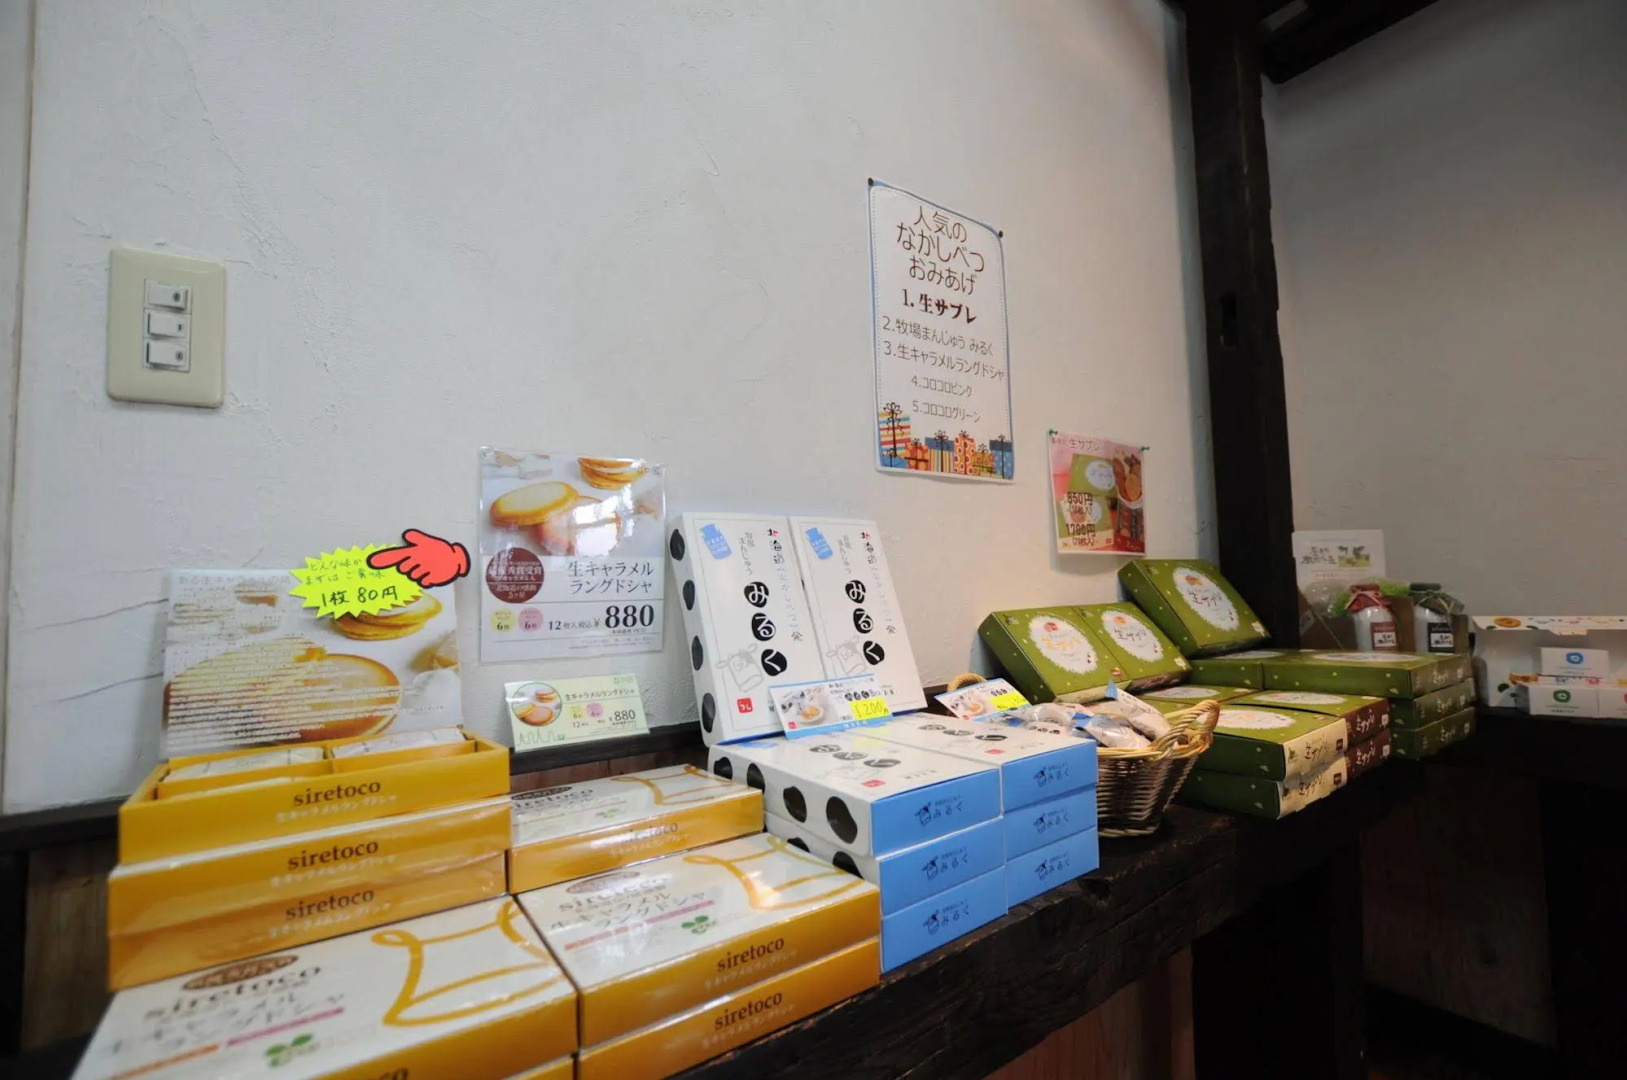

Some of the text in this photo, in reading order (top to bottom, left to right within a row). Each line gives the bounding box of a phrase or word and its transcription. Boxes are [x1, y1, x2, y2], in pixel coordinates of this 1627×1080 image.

[913, 205, 967, 243] 人気の
[896, 222, 985, 272] なかしべつ
[908, 254, 978, 295] おみあげ
[568, 560, 654, 578] 生キャラメル
[357, 585, 398, 604] 80円
[570, 579, 653, 595] ラングドシャ
[744, 581, 788, 677] みるく
[845, 580, 885, 666] みるく
[293, 781, 382, 806] siretoco
[287, 841, 379, 871] siretoco
[285, 890, 375, 920] siretoco
[717, 938, 785, 972] siretoco
[715, 992, 783, 1031] siretoco
